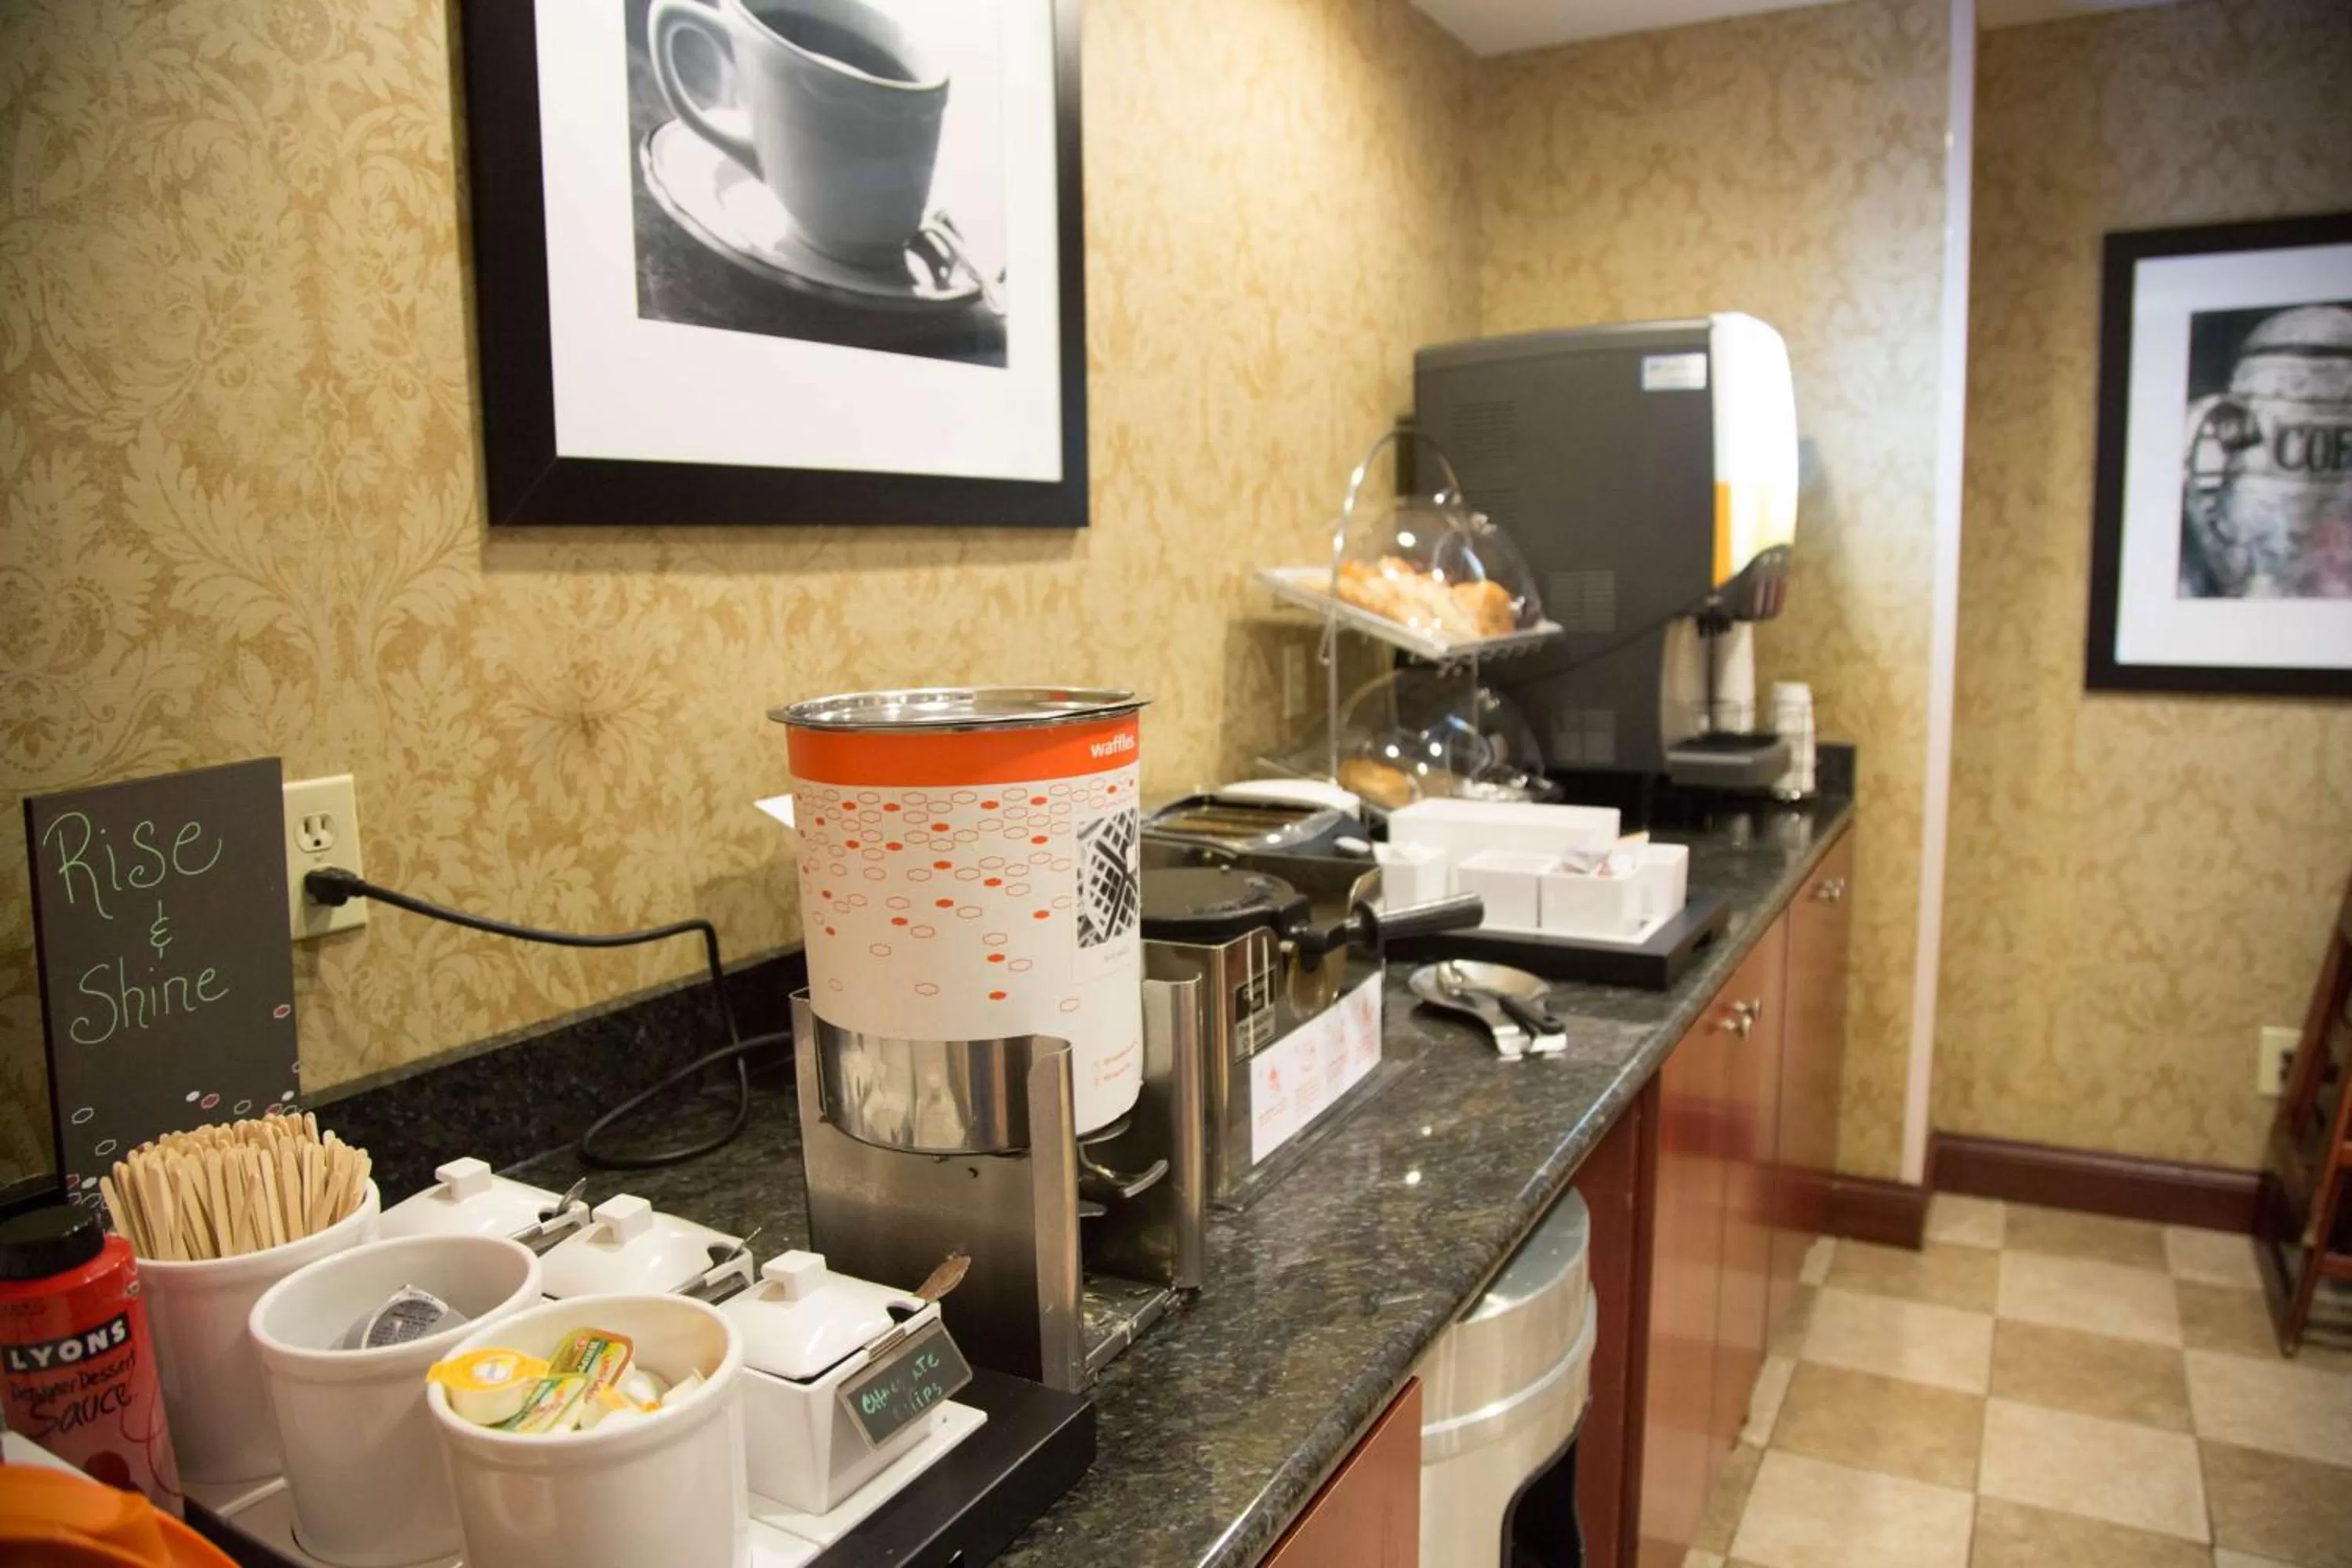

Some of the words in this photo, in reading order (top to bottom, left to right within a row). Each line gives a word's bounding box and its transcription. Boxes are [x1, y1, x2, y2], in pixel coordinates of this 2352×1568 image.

[43, 811, 222, 920] Rise
[150, 899, 173, 960] &
[69, 956, 230, 1044] Shine
[10, 1319, 127, 1370] LYONS
[26, 1382, 132, 1439] Sauce
